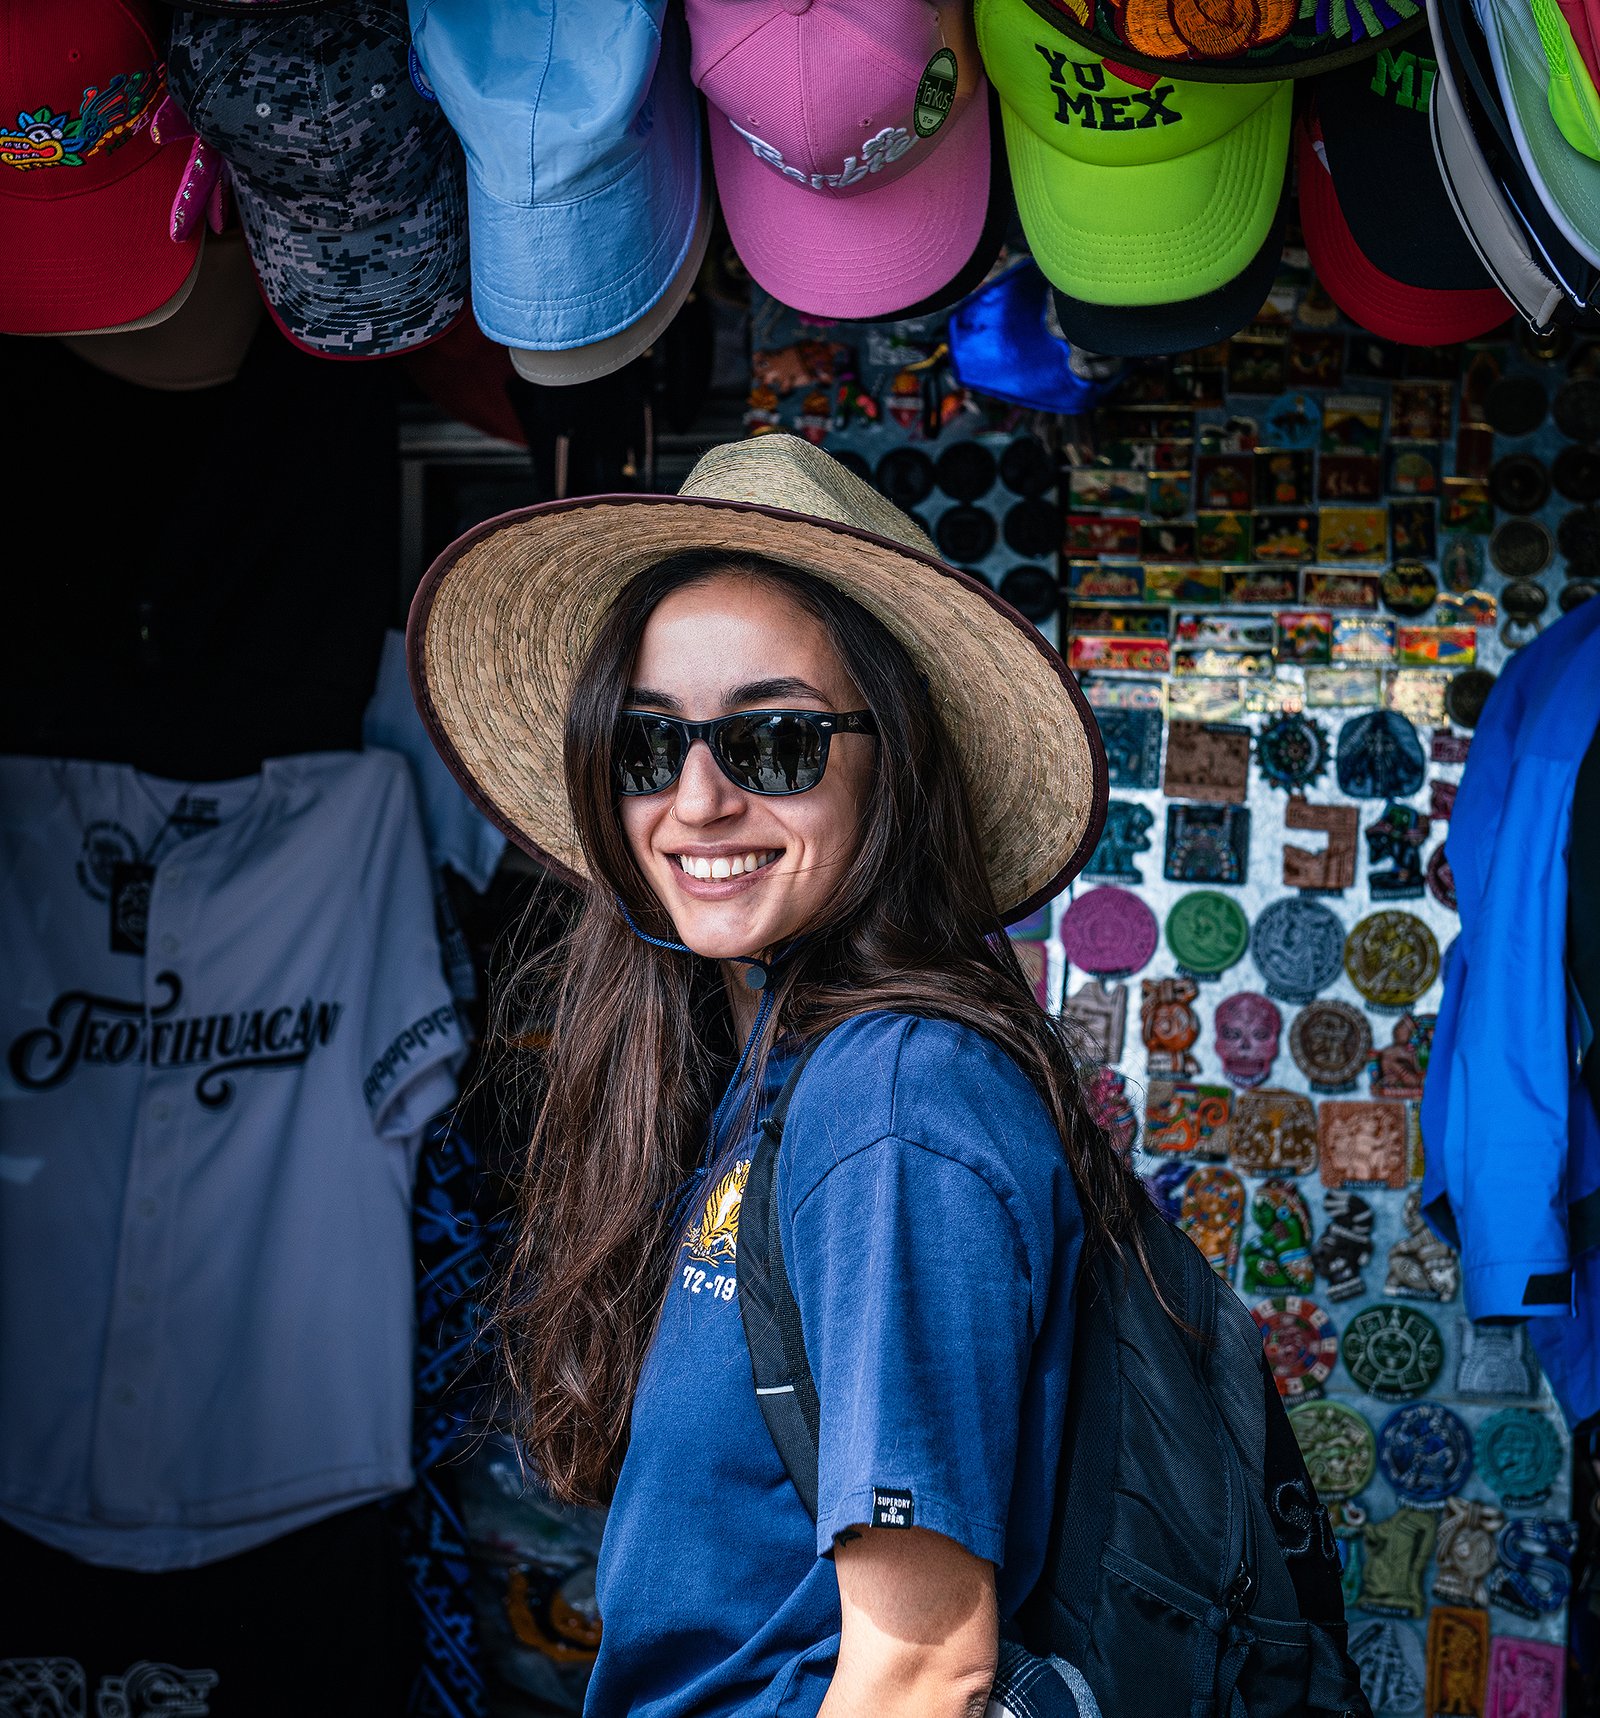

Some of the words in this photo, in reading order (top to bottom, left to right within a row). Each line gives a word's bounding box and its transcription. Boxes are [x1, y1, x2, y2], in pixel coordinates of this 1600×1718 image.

[1034, 43, 1106, 92] YO
[1050, 84, 1183, 131] MEX
[877, 1496, 911, 1509] SUPERDRY
